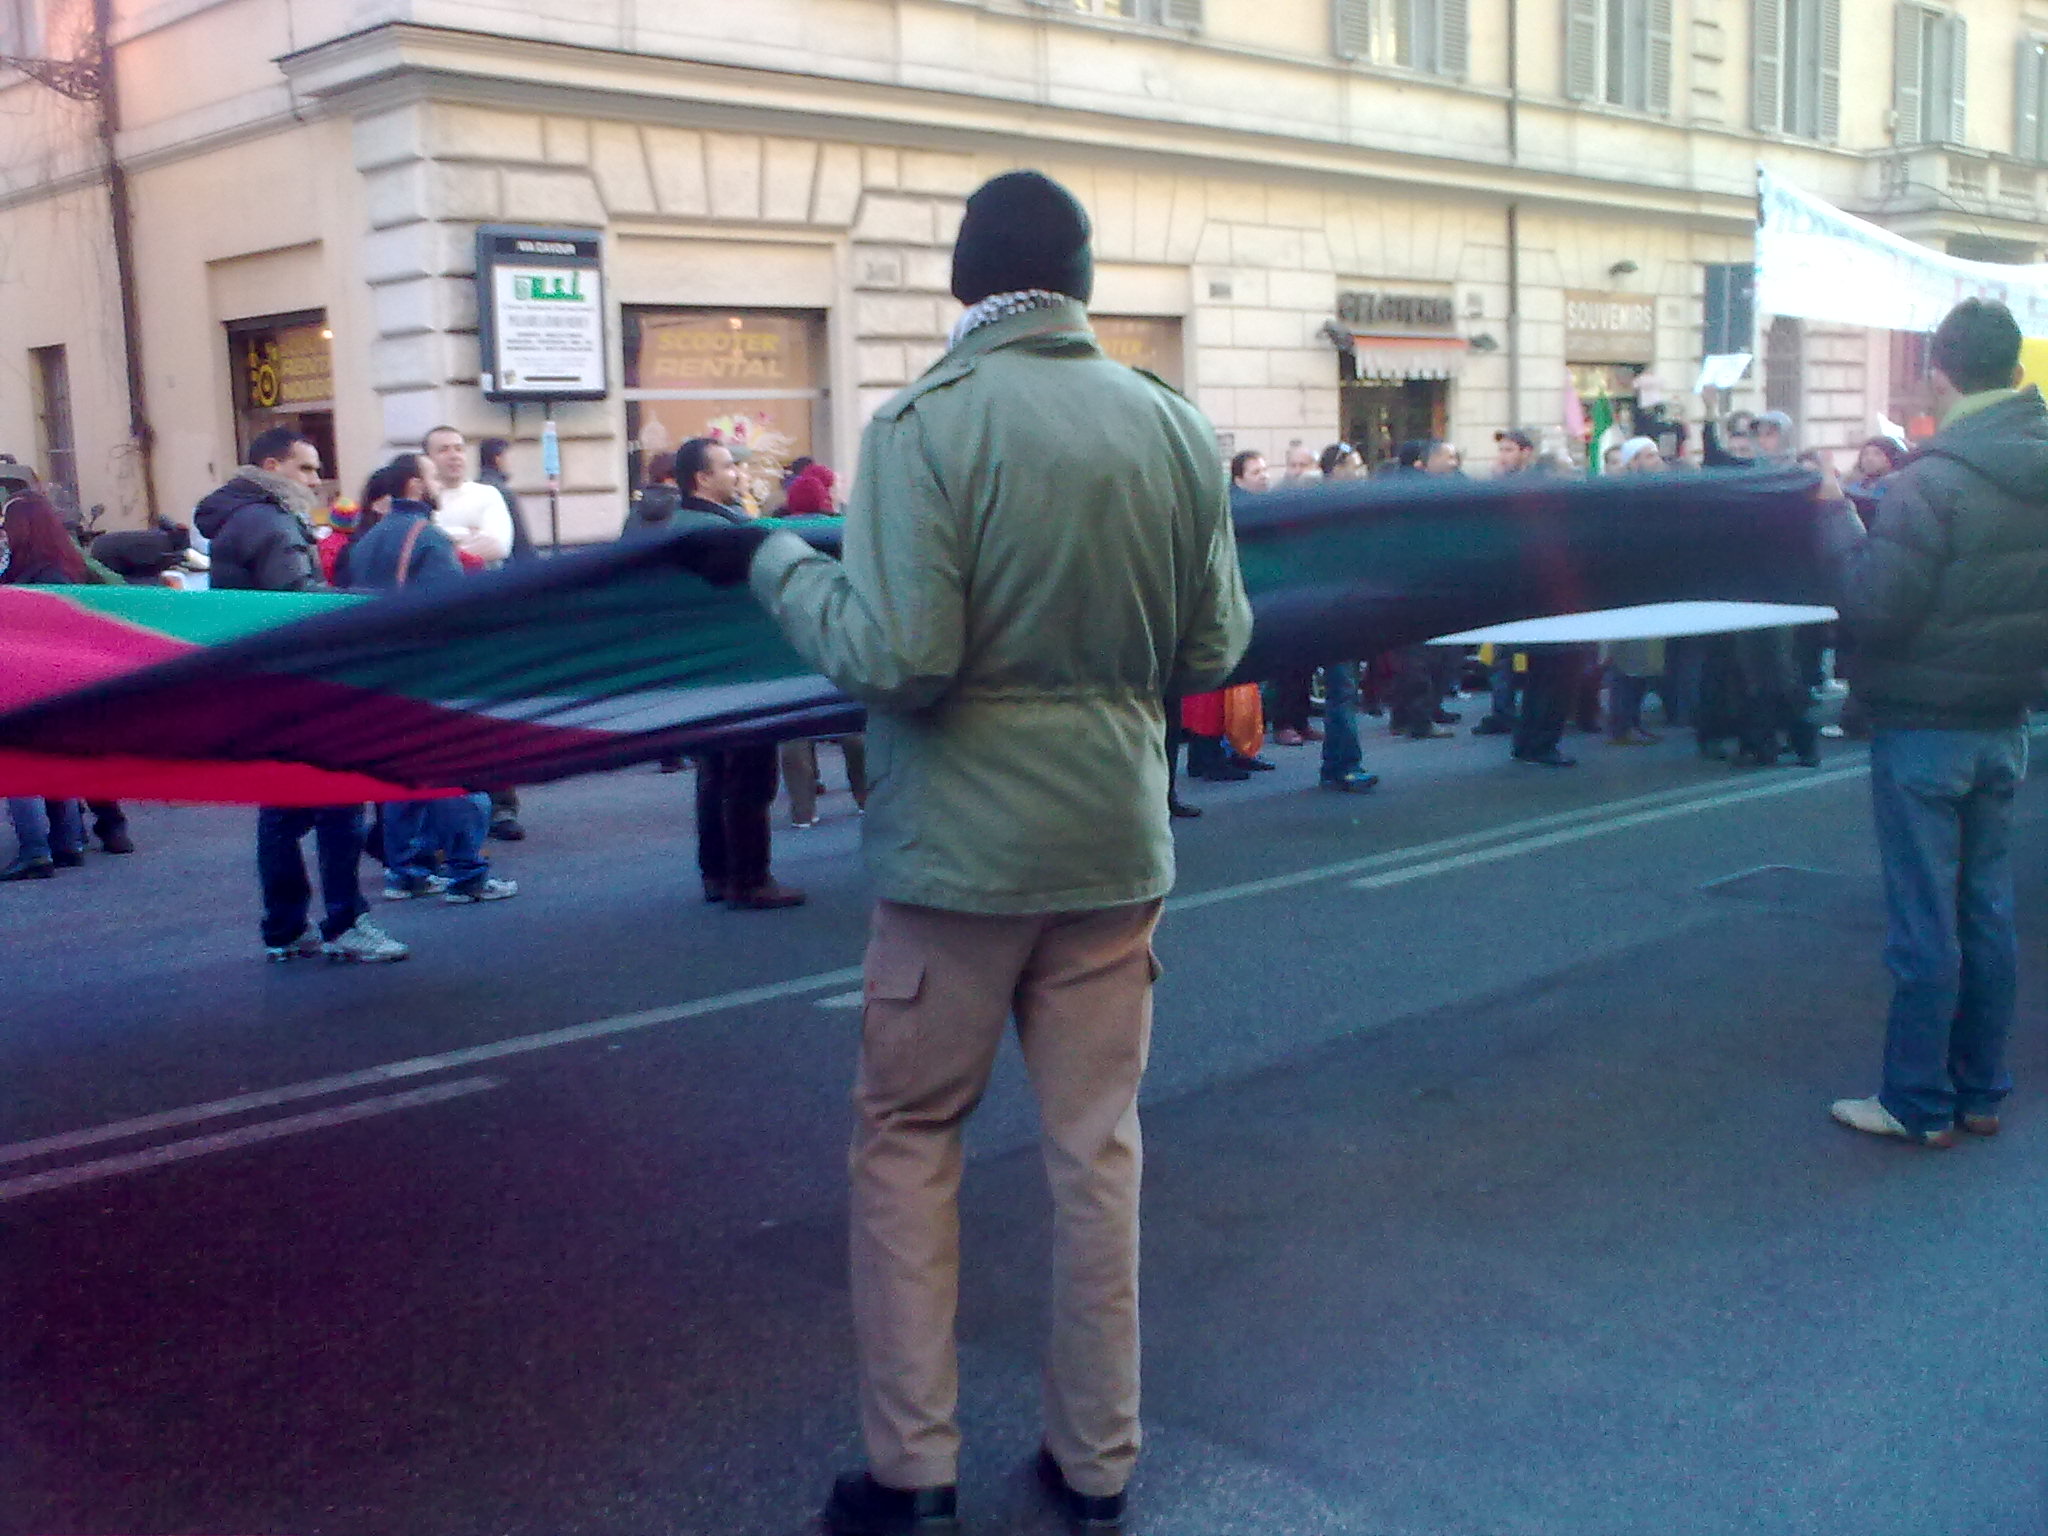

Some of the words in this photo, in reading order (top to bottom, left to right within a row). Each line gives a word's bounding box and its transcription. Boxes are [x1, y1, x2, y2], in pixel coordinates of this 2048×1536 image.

[1567, 301, 1652, 332] SOUVENIRS
[658, 331, 781, 352] SCOOTER
[655, 357, 785, 378] RENTAL
